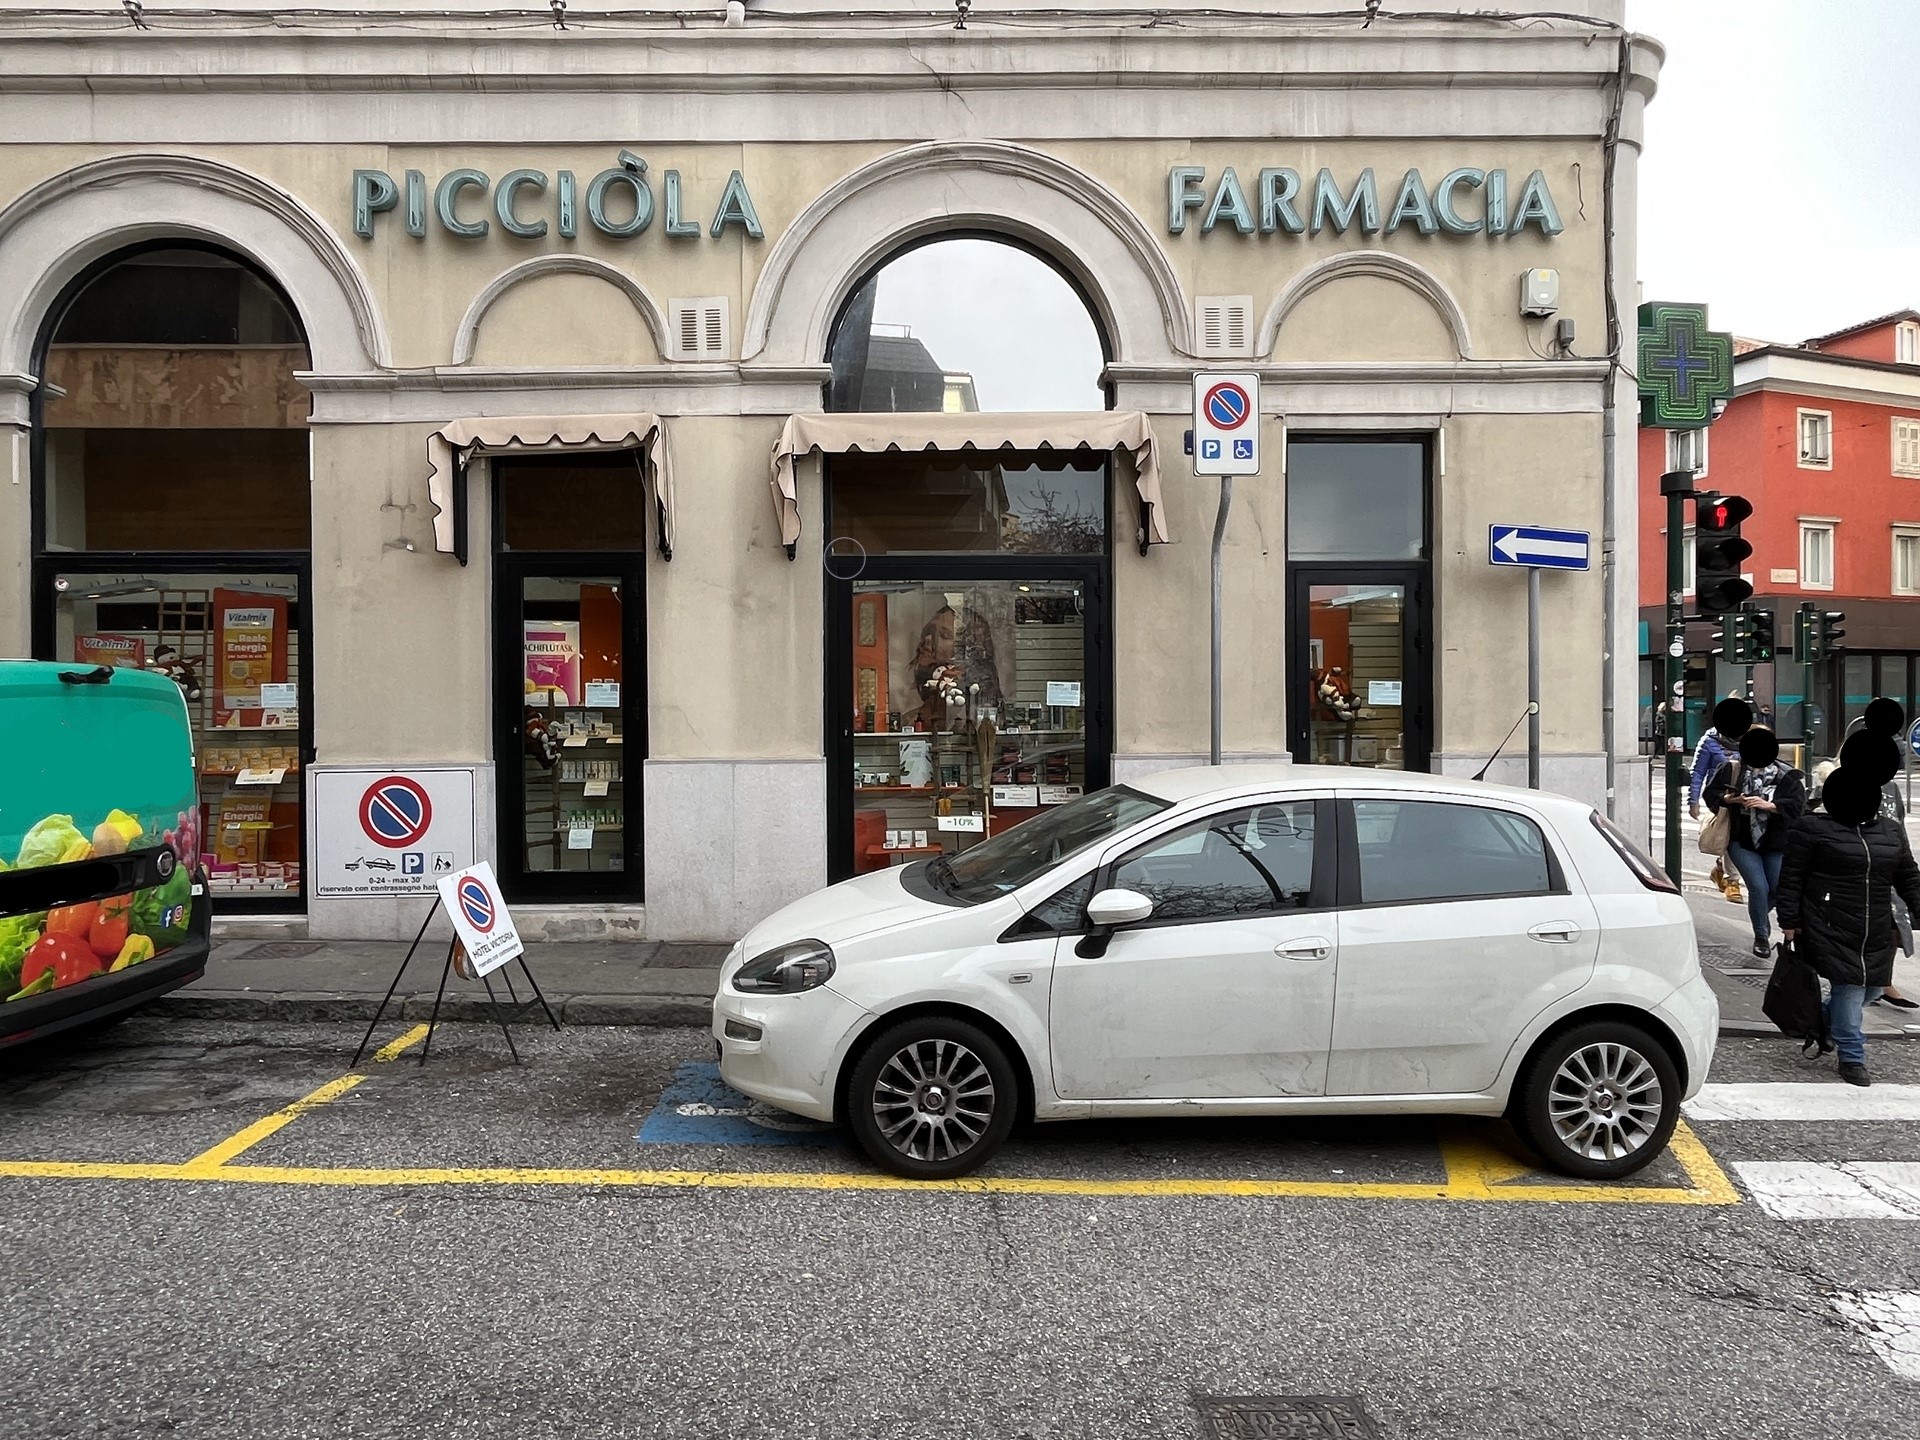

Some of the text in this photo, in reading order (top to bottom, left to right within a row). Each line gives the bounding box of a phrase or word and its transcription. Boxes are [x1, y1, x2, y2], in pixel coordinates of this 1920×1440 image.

[353, 150, 765, 239] PICCIÒLA
[1168, 166, 1564, 237] FARMACIA
[1205, 441, 1218, 457] P
[228, 612, 268, 622] Vitalmix
[239, 634, 267, 642] Reale
[83, 637, 136, 650] Vitalmix
[227, 643, 267, 653] Energia
[223, 811, 264, 821] Energia
[946, 818, 974, 826] -10%
[404, 854, 421, 873] P
[368, 877, 386, 885] 0-24
[320, 885, 353, 893] riservato
[472, 931, 514, 959] HOTEL VICTORIA
